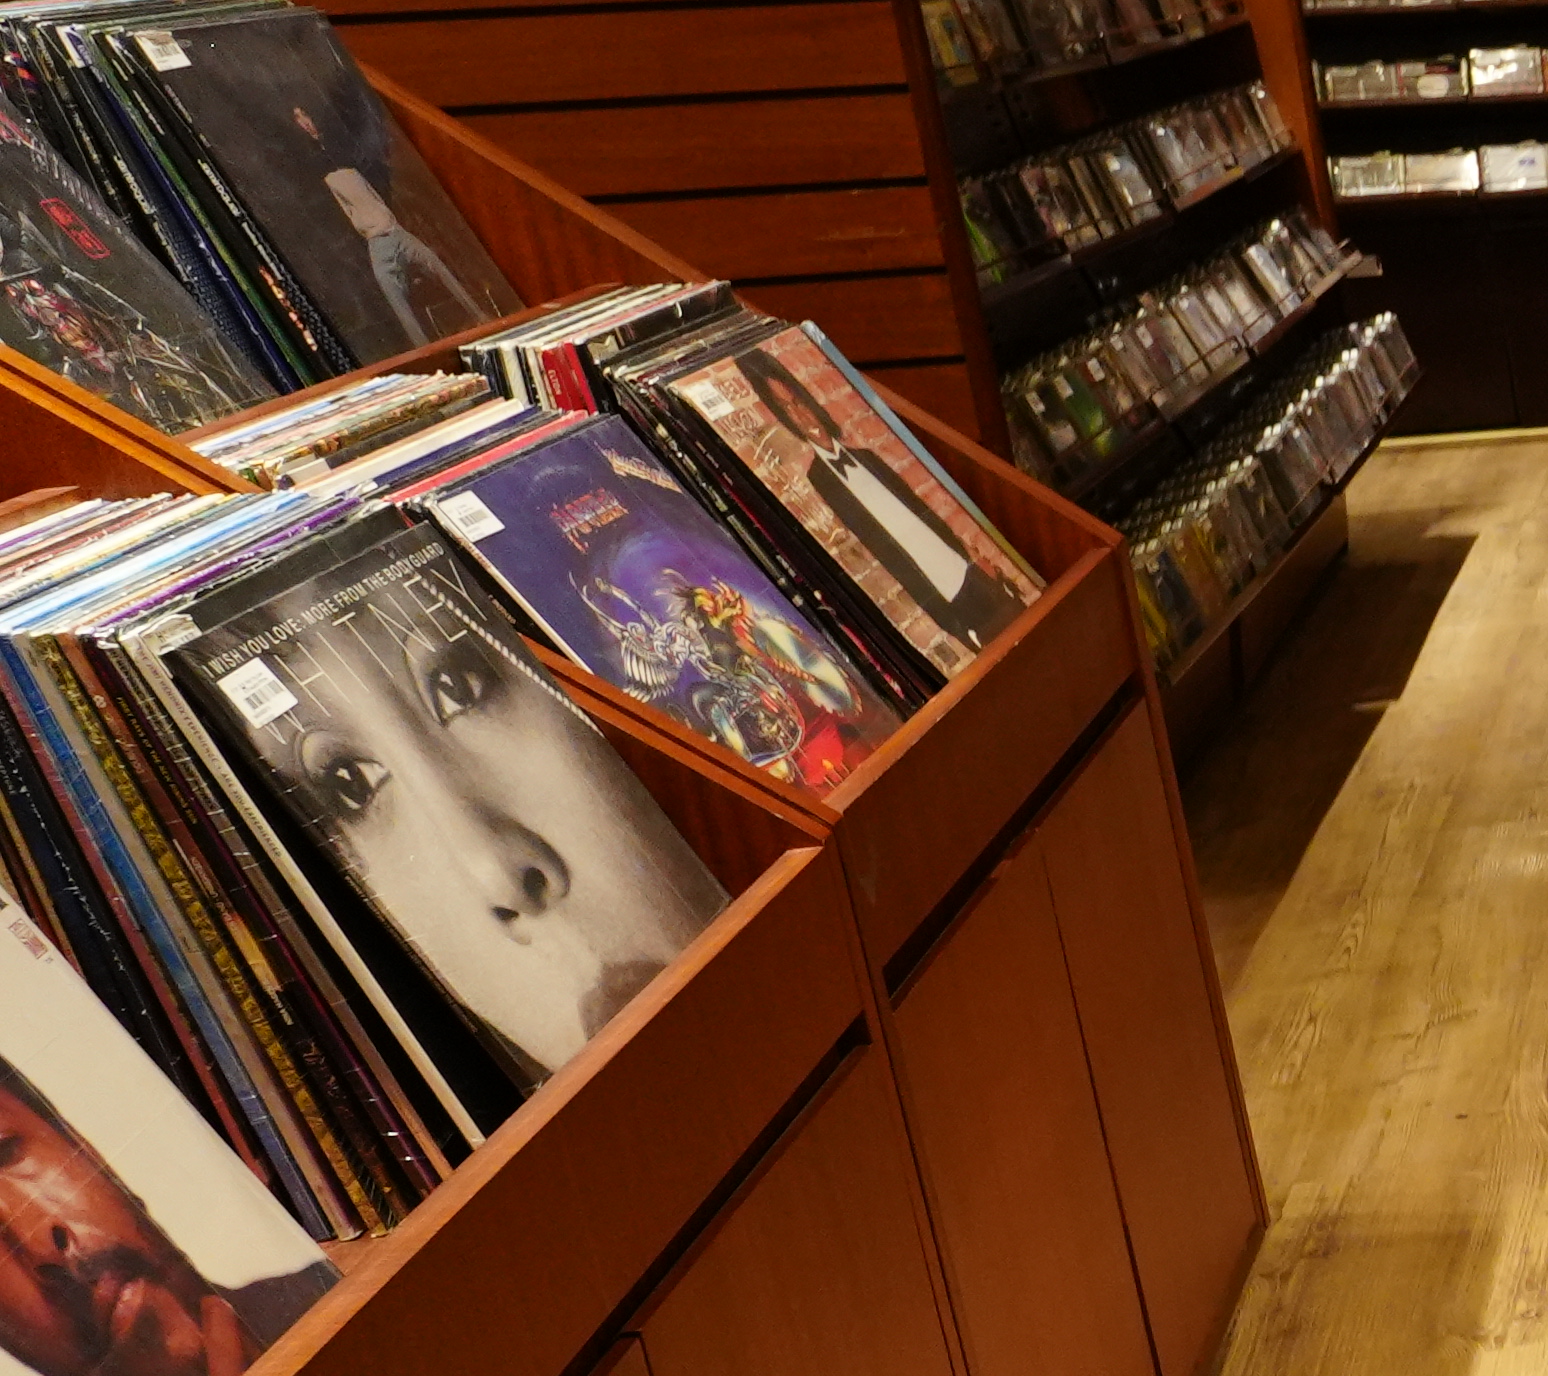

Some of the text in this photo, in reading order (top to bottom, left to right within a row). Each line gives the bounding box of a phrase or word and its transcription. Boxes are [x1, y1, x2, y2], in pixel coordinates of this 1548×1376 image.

[209, 650, 247, 676] WISH
[239, 635, 271, 663] YOU
[300, 598, 340, 628] MORE
[334, 584, 370, 614] FROM
[363, 571, 390, 595] THE
[381, 541, 445, 586] BODYGUARD
